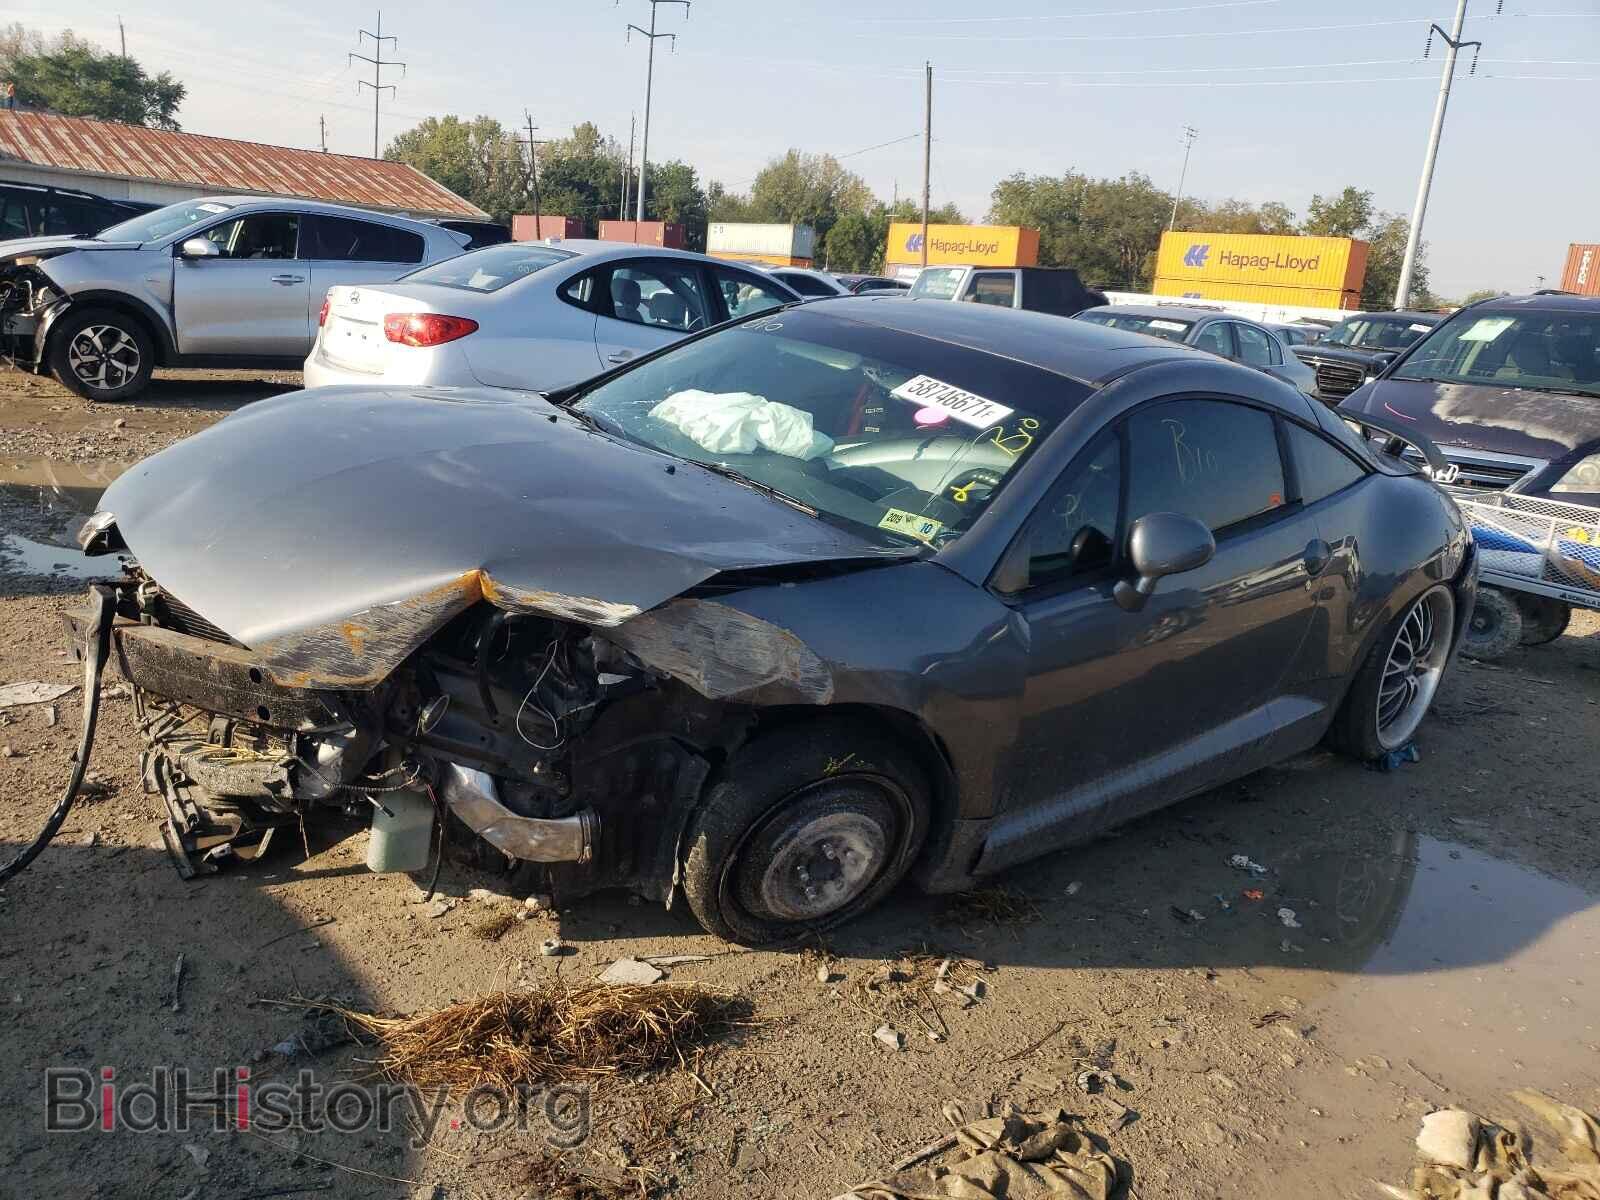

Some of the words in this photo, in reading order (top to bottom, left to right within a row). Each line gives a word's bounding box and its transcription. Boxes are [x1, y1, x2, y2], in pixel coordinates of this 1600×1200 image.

[931, 238, 999, 256] Hapag-Lloyd
[1219, 250, 1320, 272] Hapag-Lloyd
[886, 513, 904, 524] 2019
[919, 522, 933, 534] 10
